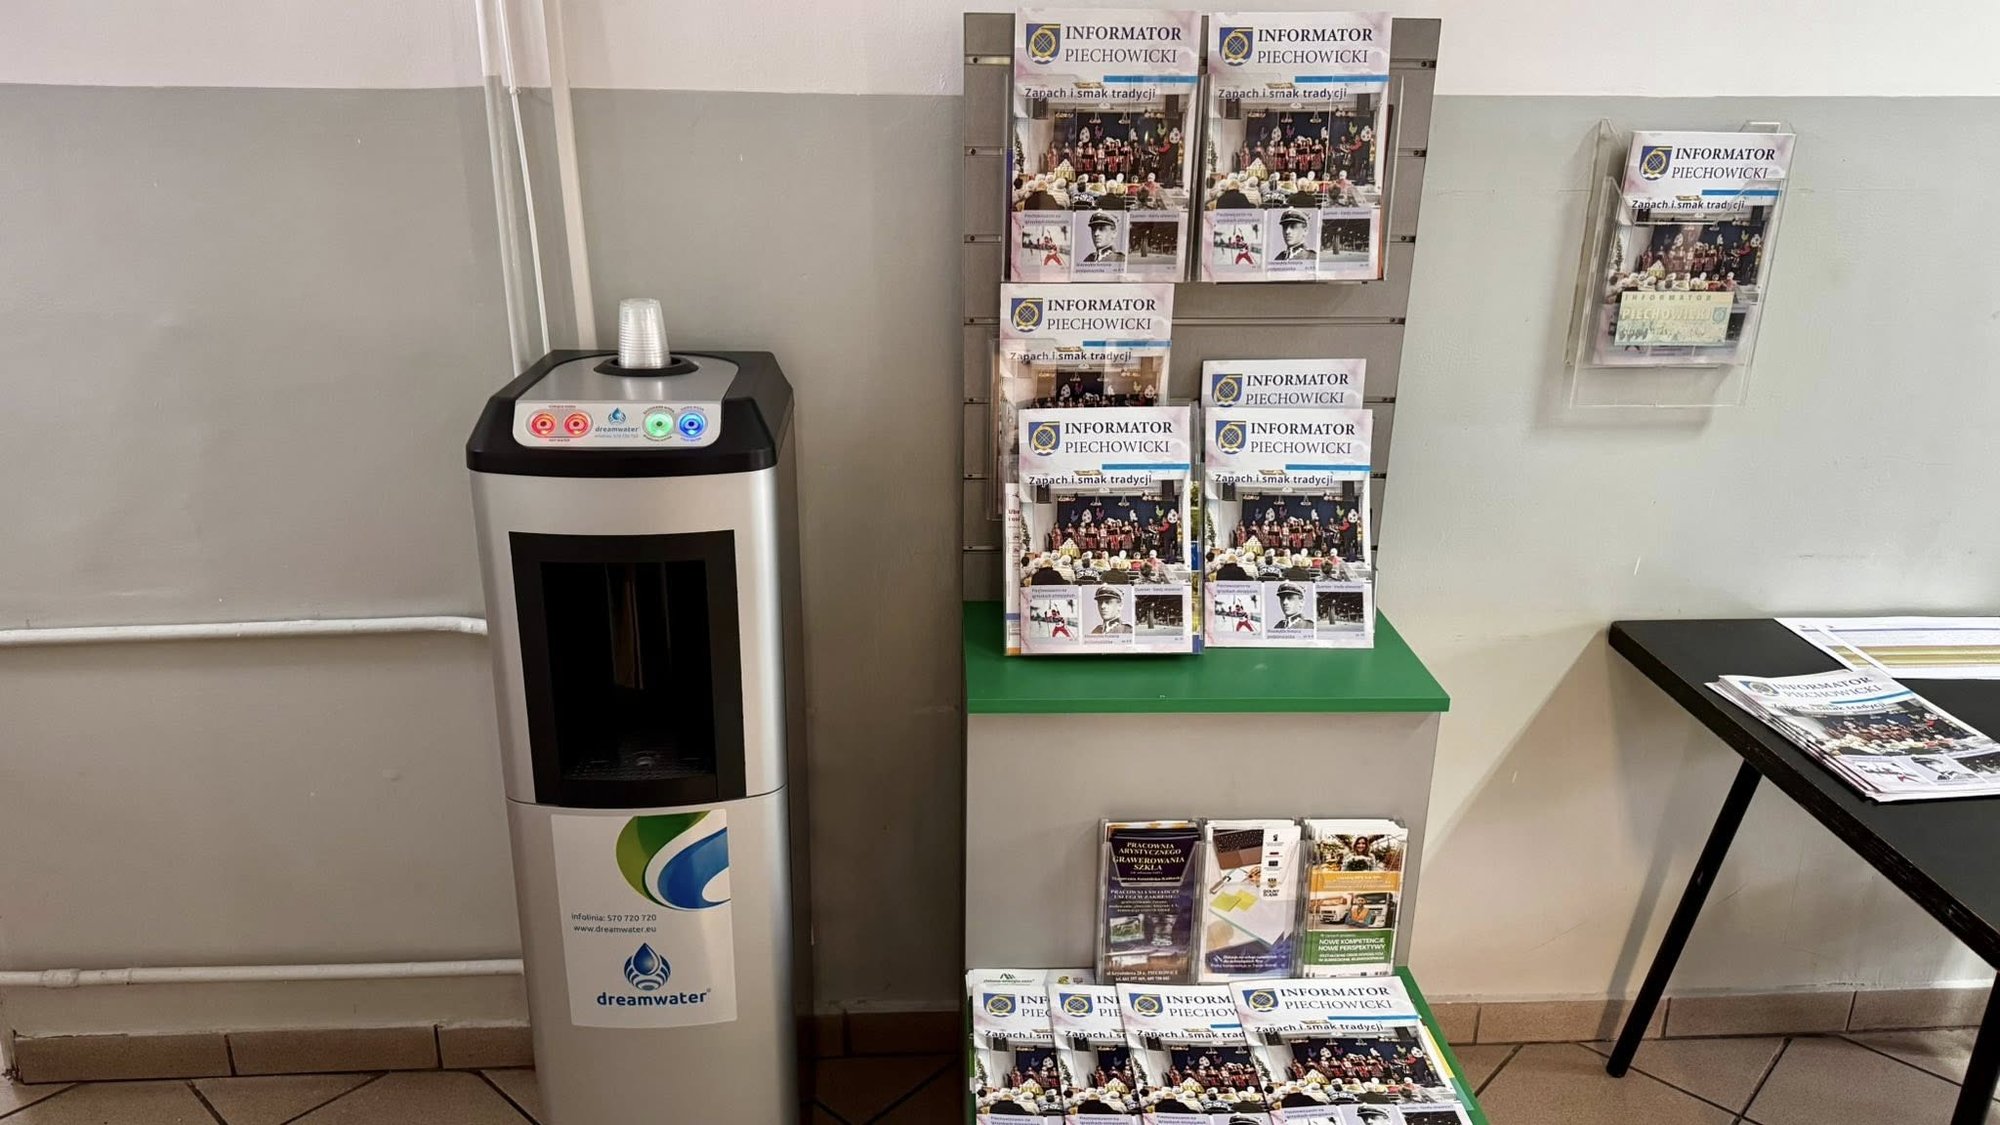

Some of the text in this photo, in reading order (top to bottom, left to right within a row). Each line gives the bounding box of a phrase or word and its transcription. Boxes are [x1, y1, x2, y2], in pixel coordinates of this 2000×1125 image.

[1065, 25, 1182, 42] INFORMATOR
[1257, 28, 1373, 43] INFORMATOR
[1065, 48, 1177, 64] PIECHOWICKI
[1257, 49, 1368, 65] PIECHOWICKI
[1025, 87, 1067, 101] Zapach
[1076, 87, 1109, 99] smak
[1112, 87, 1156, 101] tradycji
[1218, 87, 1260, 101] Zapach
[1269, 87, 1300, 99] smak
[1303, 87, 1347, 101] tradycji
[1675, 147, 1776, 162] INFORMATOR
[1671, 166, 1768, 180] PIECHOWICKI
[1632, 199, 1668, 211] Zapach
[1677, 199, 1703, 210] smak
[1706, 199, 1745, 211] tradycji
[1047, 299, 1156, 312] INFORMATOR
[1047, 317, 1152, 331] PIECHOWICKI
[1010, 351, 1049, 363] Zapach
[1058, 351, 1088, 362] smak
[1091, 350, 1132, 364] tradycji
[1246, 373, 1349, 387] INFORMATOR
[1245, 392, 1344, 406] PIECHOWICKI
[1065, 421, 1172, 435] INFORMATOR
[1250, 422, 1355, 436] INFORMATOR
[1065, 440, 1170, 454] PIECHOWICKI
[1250, 441, 1351, 455] PIECHOWICKI
[1028, 475, 1069, 488] Zapach
[1077, 475, 1107, 486] smak
[1110, 474, 1152, 487] tradycji
[1215, 474, 1253, 487] Zapach
[1262, 474, 1290, 485] smak
[1293, 474, 1333, 487] tradycji
[1772, 676, 1871, 691] INFORMATOR
[1783, 685, 1882, 698] PIECHOWICKI
[1112, 856, 1185, 864] GRAWEROWANIA
[571, 913, 605, 921] infolinia:
[607, 914, 622, 922] 570
[624, 914, 640, 922] 720
[573, 925, 657, 933] www.dreamwater.eu
[596, 991, 708, 1006] dreamwater
[1280, 987, 1391, 997] INFORMATOR
[1285, 1000, 1392, 1010] PIECHOWICKI
[985, 1029, 1026, 1039] Zapach
[1065, 1029, 1107, 1039] Zapach
[1137, 1029, 1178, 1039] Zapach
[1187, 1030, 1219, 1039] smak
[1255, 1025, 1297, 1035] Zapach
[1306, 1023, 1337, 1031] smak
[1340, 1023, 1384, 1032] tradycji
